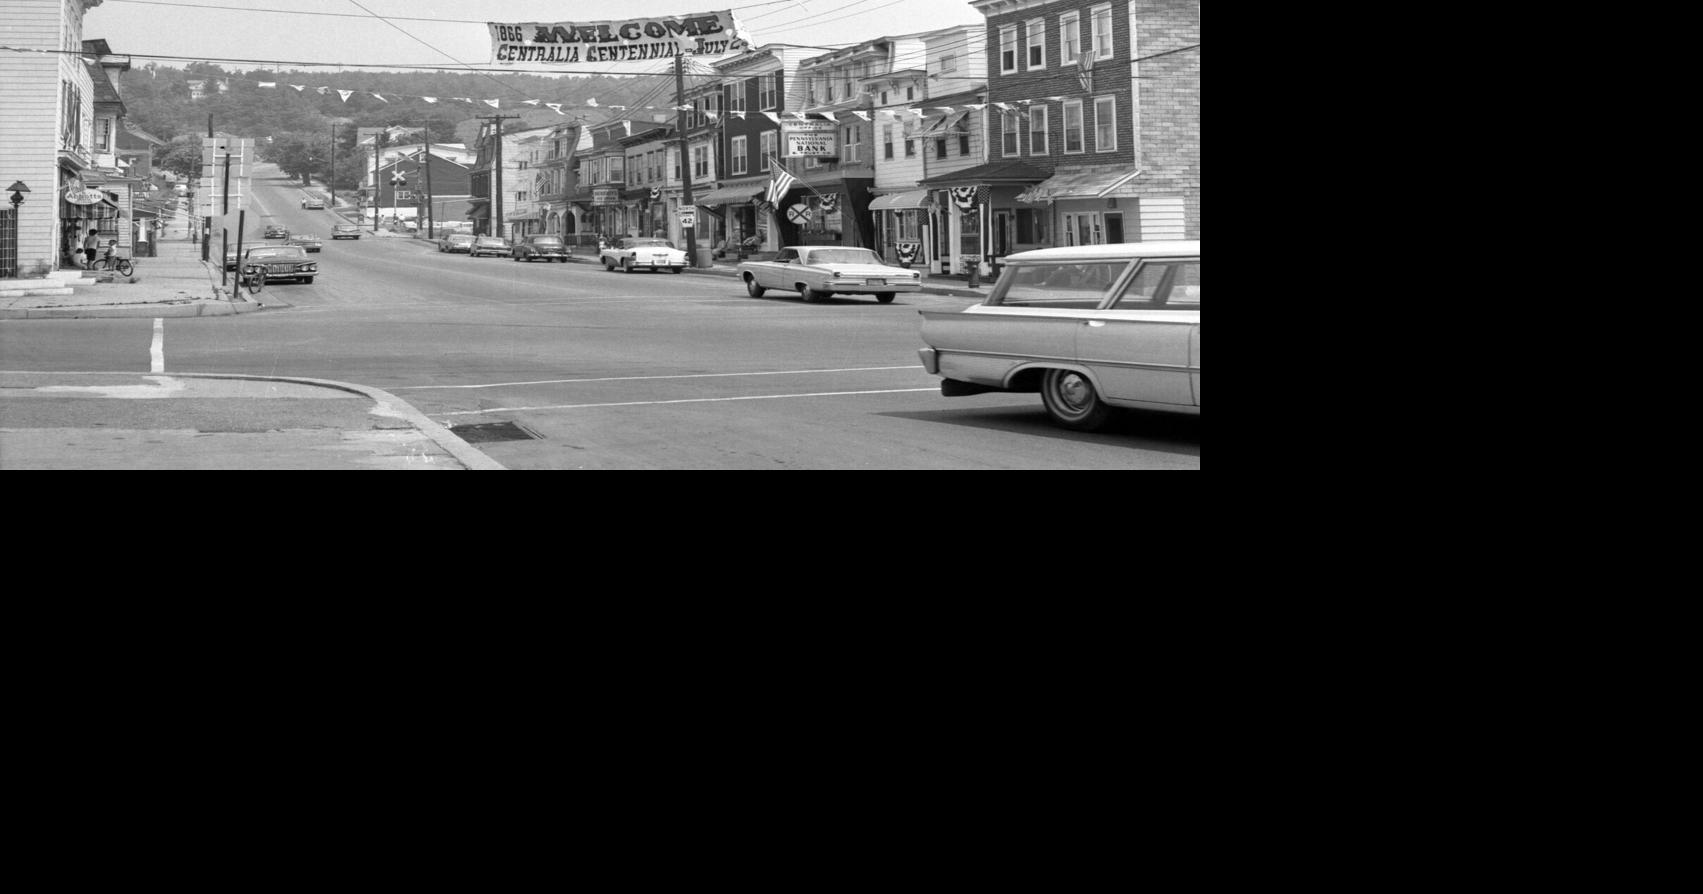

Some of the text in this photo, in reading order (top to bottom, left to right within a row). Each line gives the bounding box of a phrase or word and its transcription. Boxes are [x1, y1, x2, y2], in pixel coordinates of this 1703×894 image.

[494, 15, 724, 43] 1866 WELCOME
[497, 44, 580, 62] CENTRALIA
[586, 41, 684, 62] CENTENNIAL
